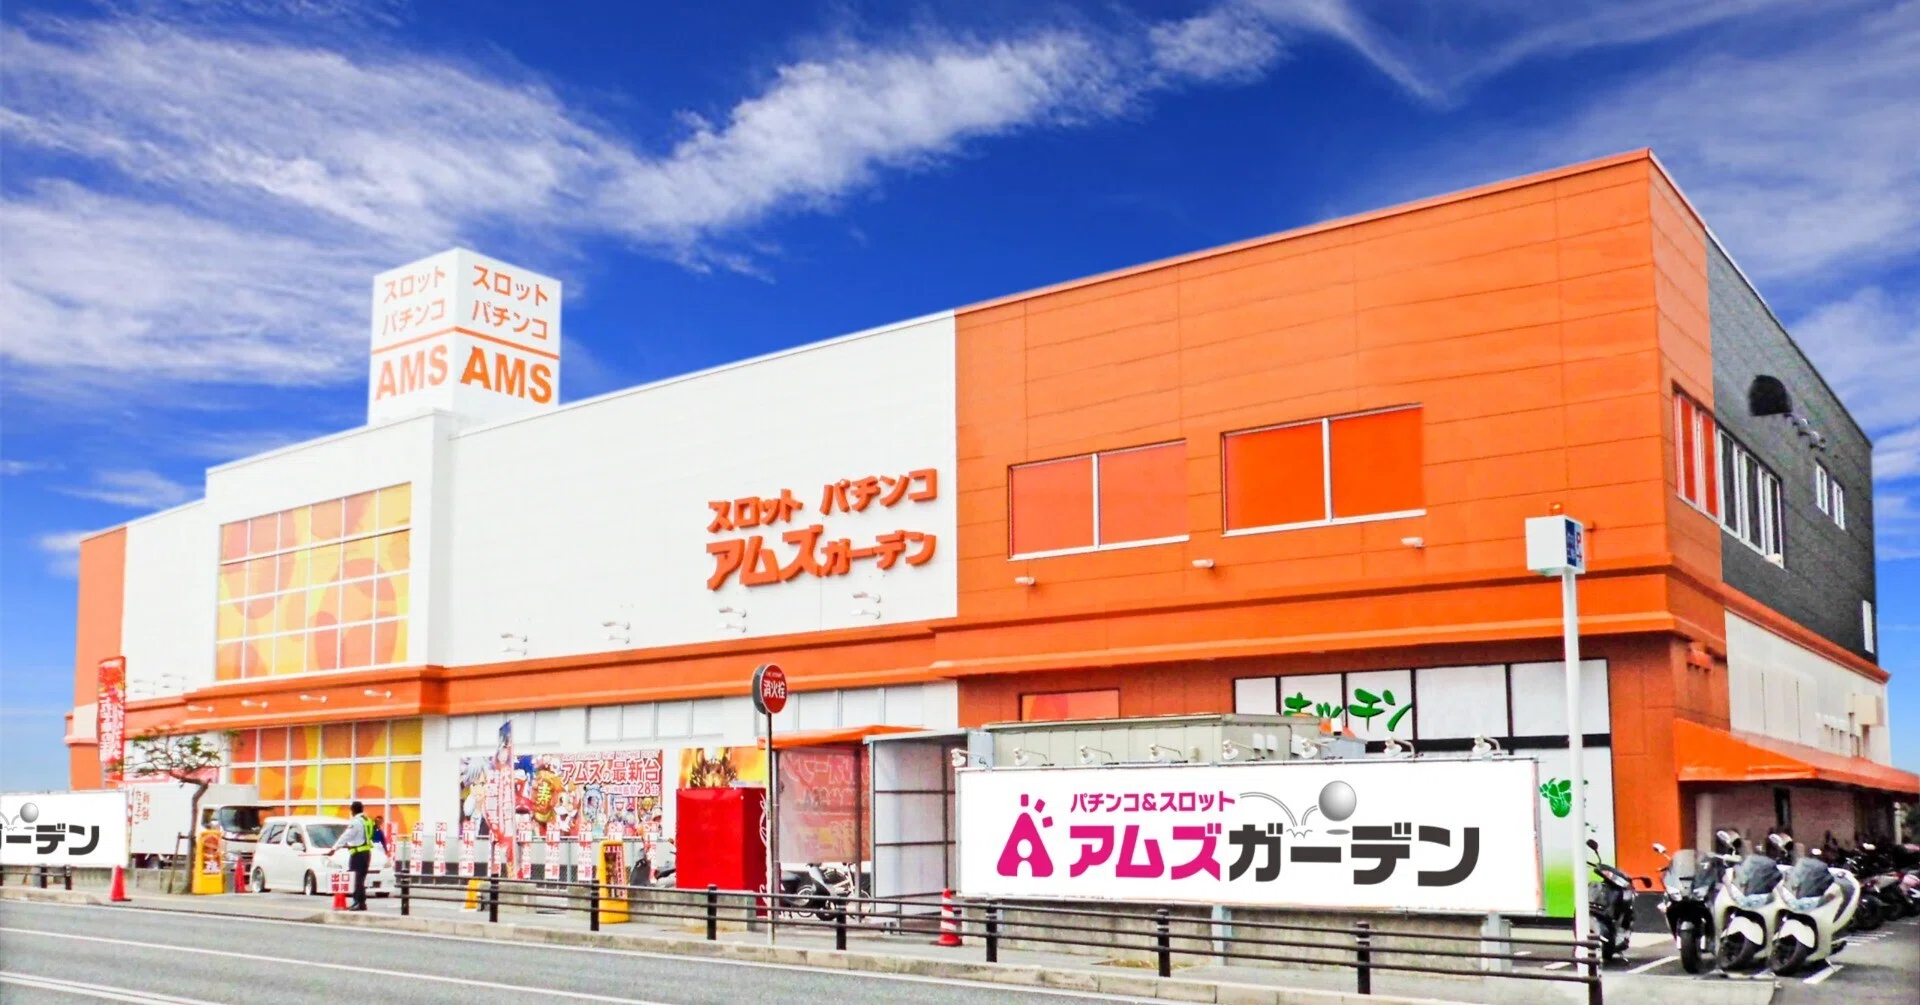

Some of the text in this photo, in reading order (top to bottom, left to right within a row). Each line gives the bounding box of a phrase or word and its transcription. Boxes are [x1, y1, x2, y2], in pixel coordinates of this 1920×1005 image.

[384, 266, 445, 303] スロット
[473, 265, 548, 306] スロット
[382, 299, 445, 336] パチンコ
[472, 300, 548, 340] パチンコ
[375, 345, 448, 401] AMS
[460, 345, 552, 404] AMS
[707, 468, 937, 533] スロット パチンコ
[706, 525, 936, 591] アムズガーデン
[763, 680, 785, 698] 消火栓
[1070, 791, 1235, 813] パチンコ&スロット
[0, 823, 100, 855] ーデン
[1070, 822, 1479, 887] アムズガーデン
